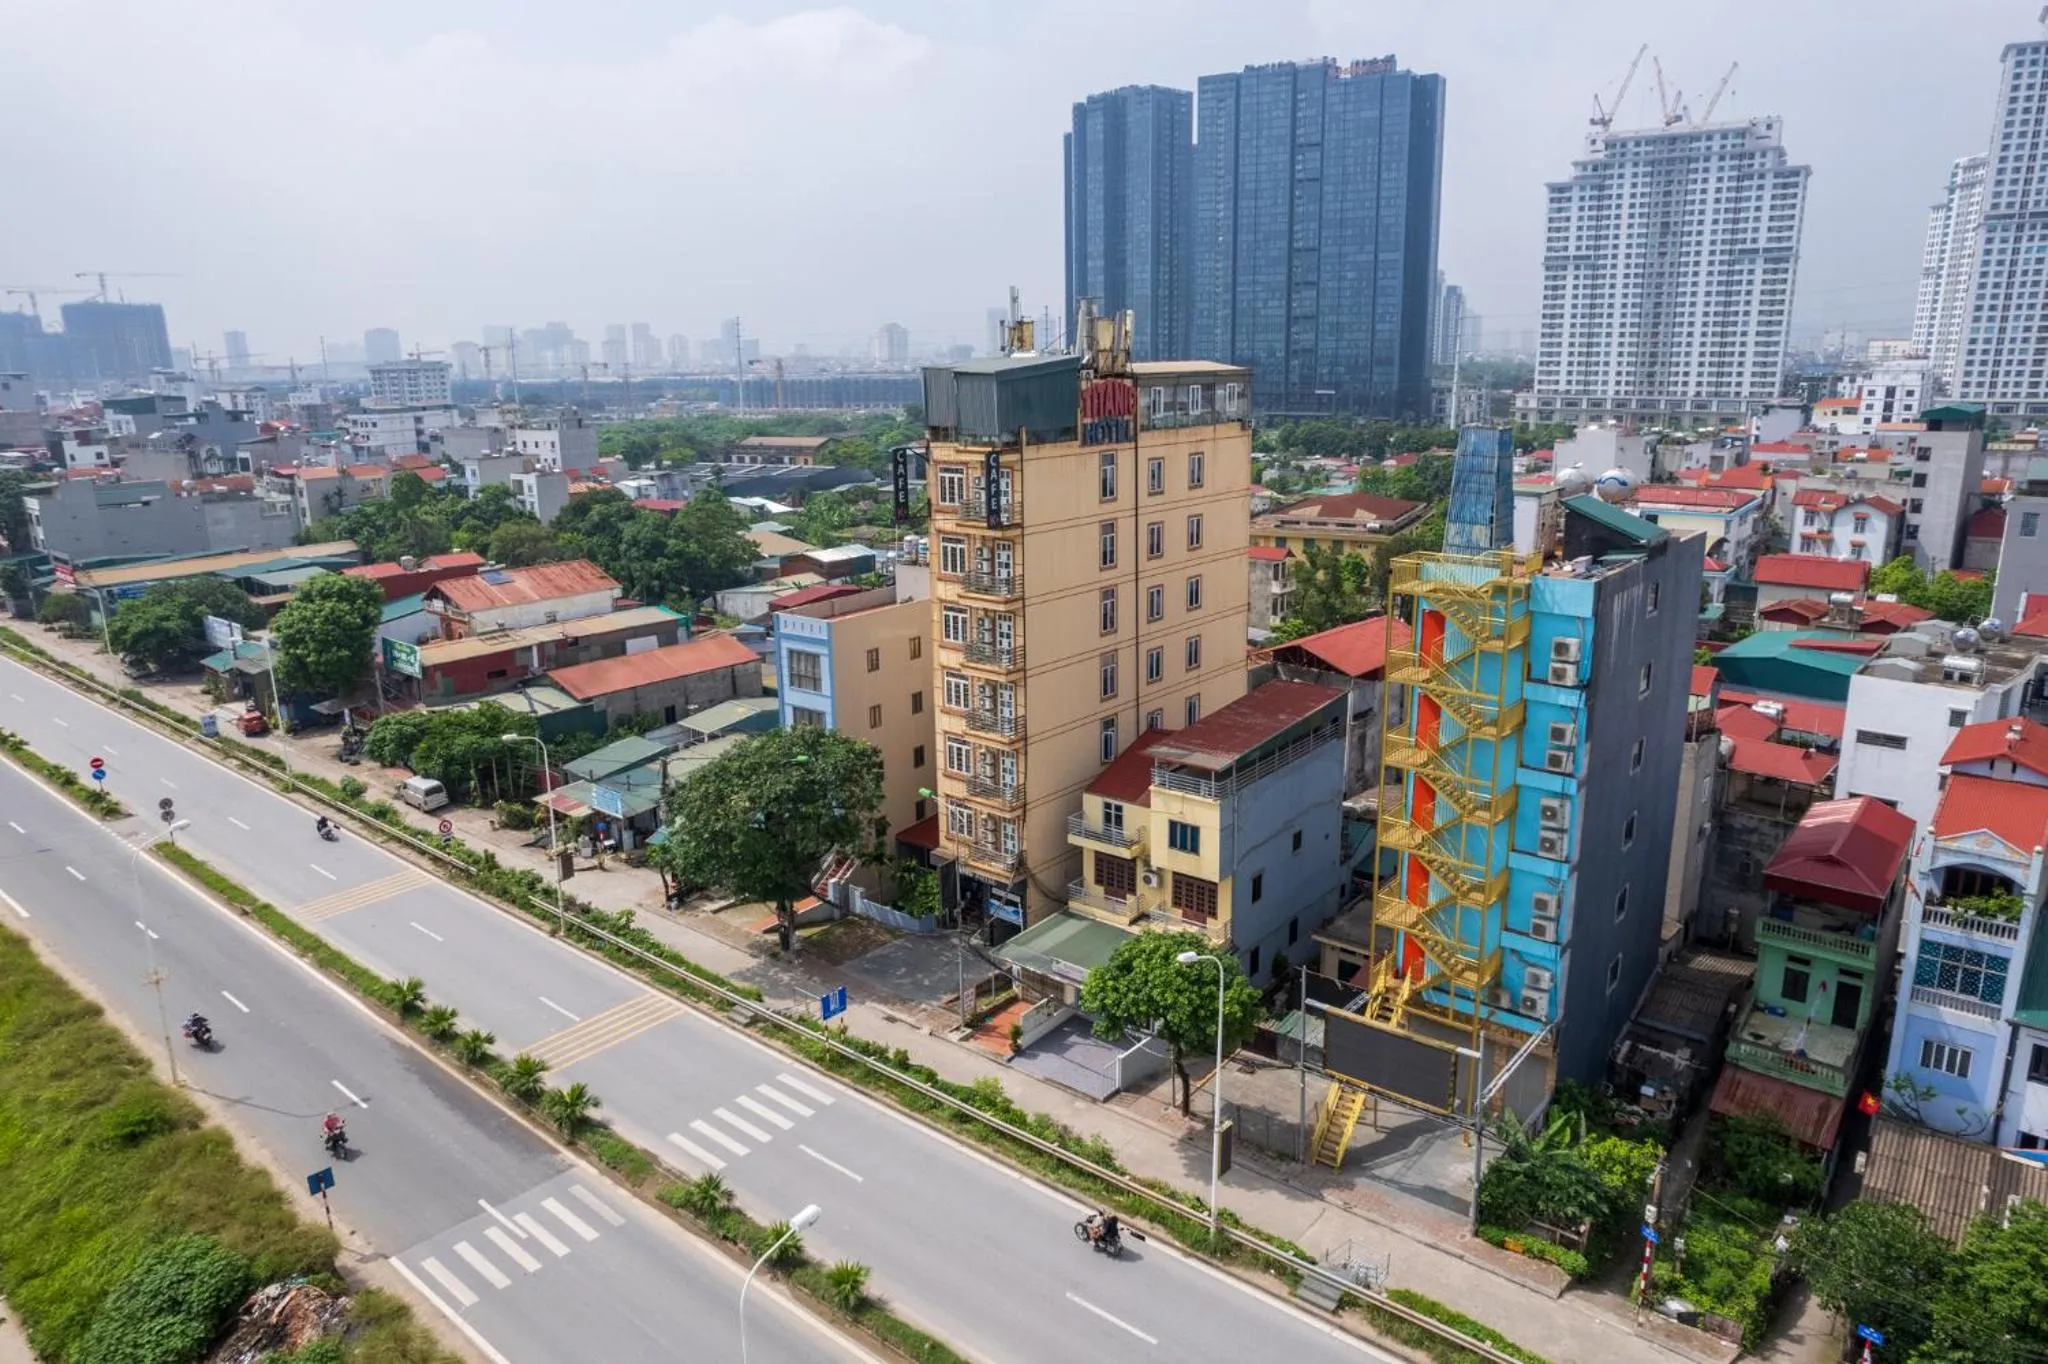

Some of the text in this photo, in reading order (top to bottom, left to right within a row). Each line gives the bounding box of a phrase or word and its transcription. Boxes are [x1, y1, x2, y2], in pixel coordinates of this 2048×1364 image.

[1082, 379, 1136, 418] TITANIC
[896, 450, 906, 503] CAFE
[989, 453, 998, 510] CAFE
